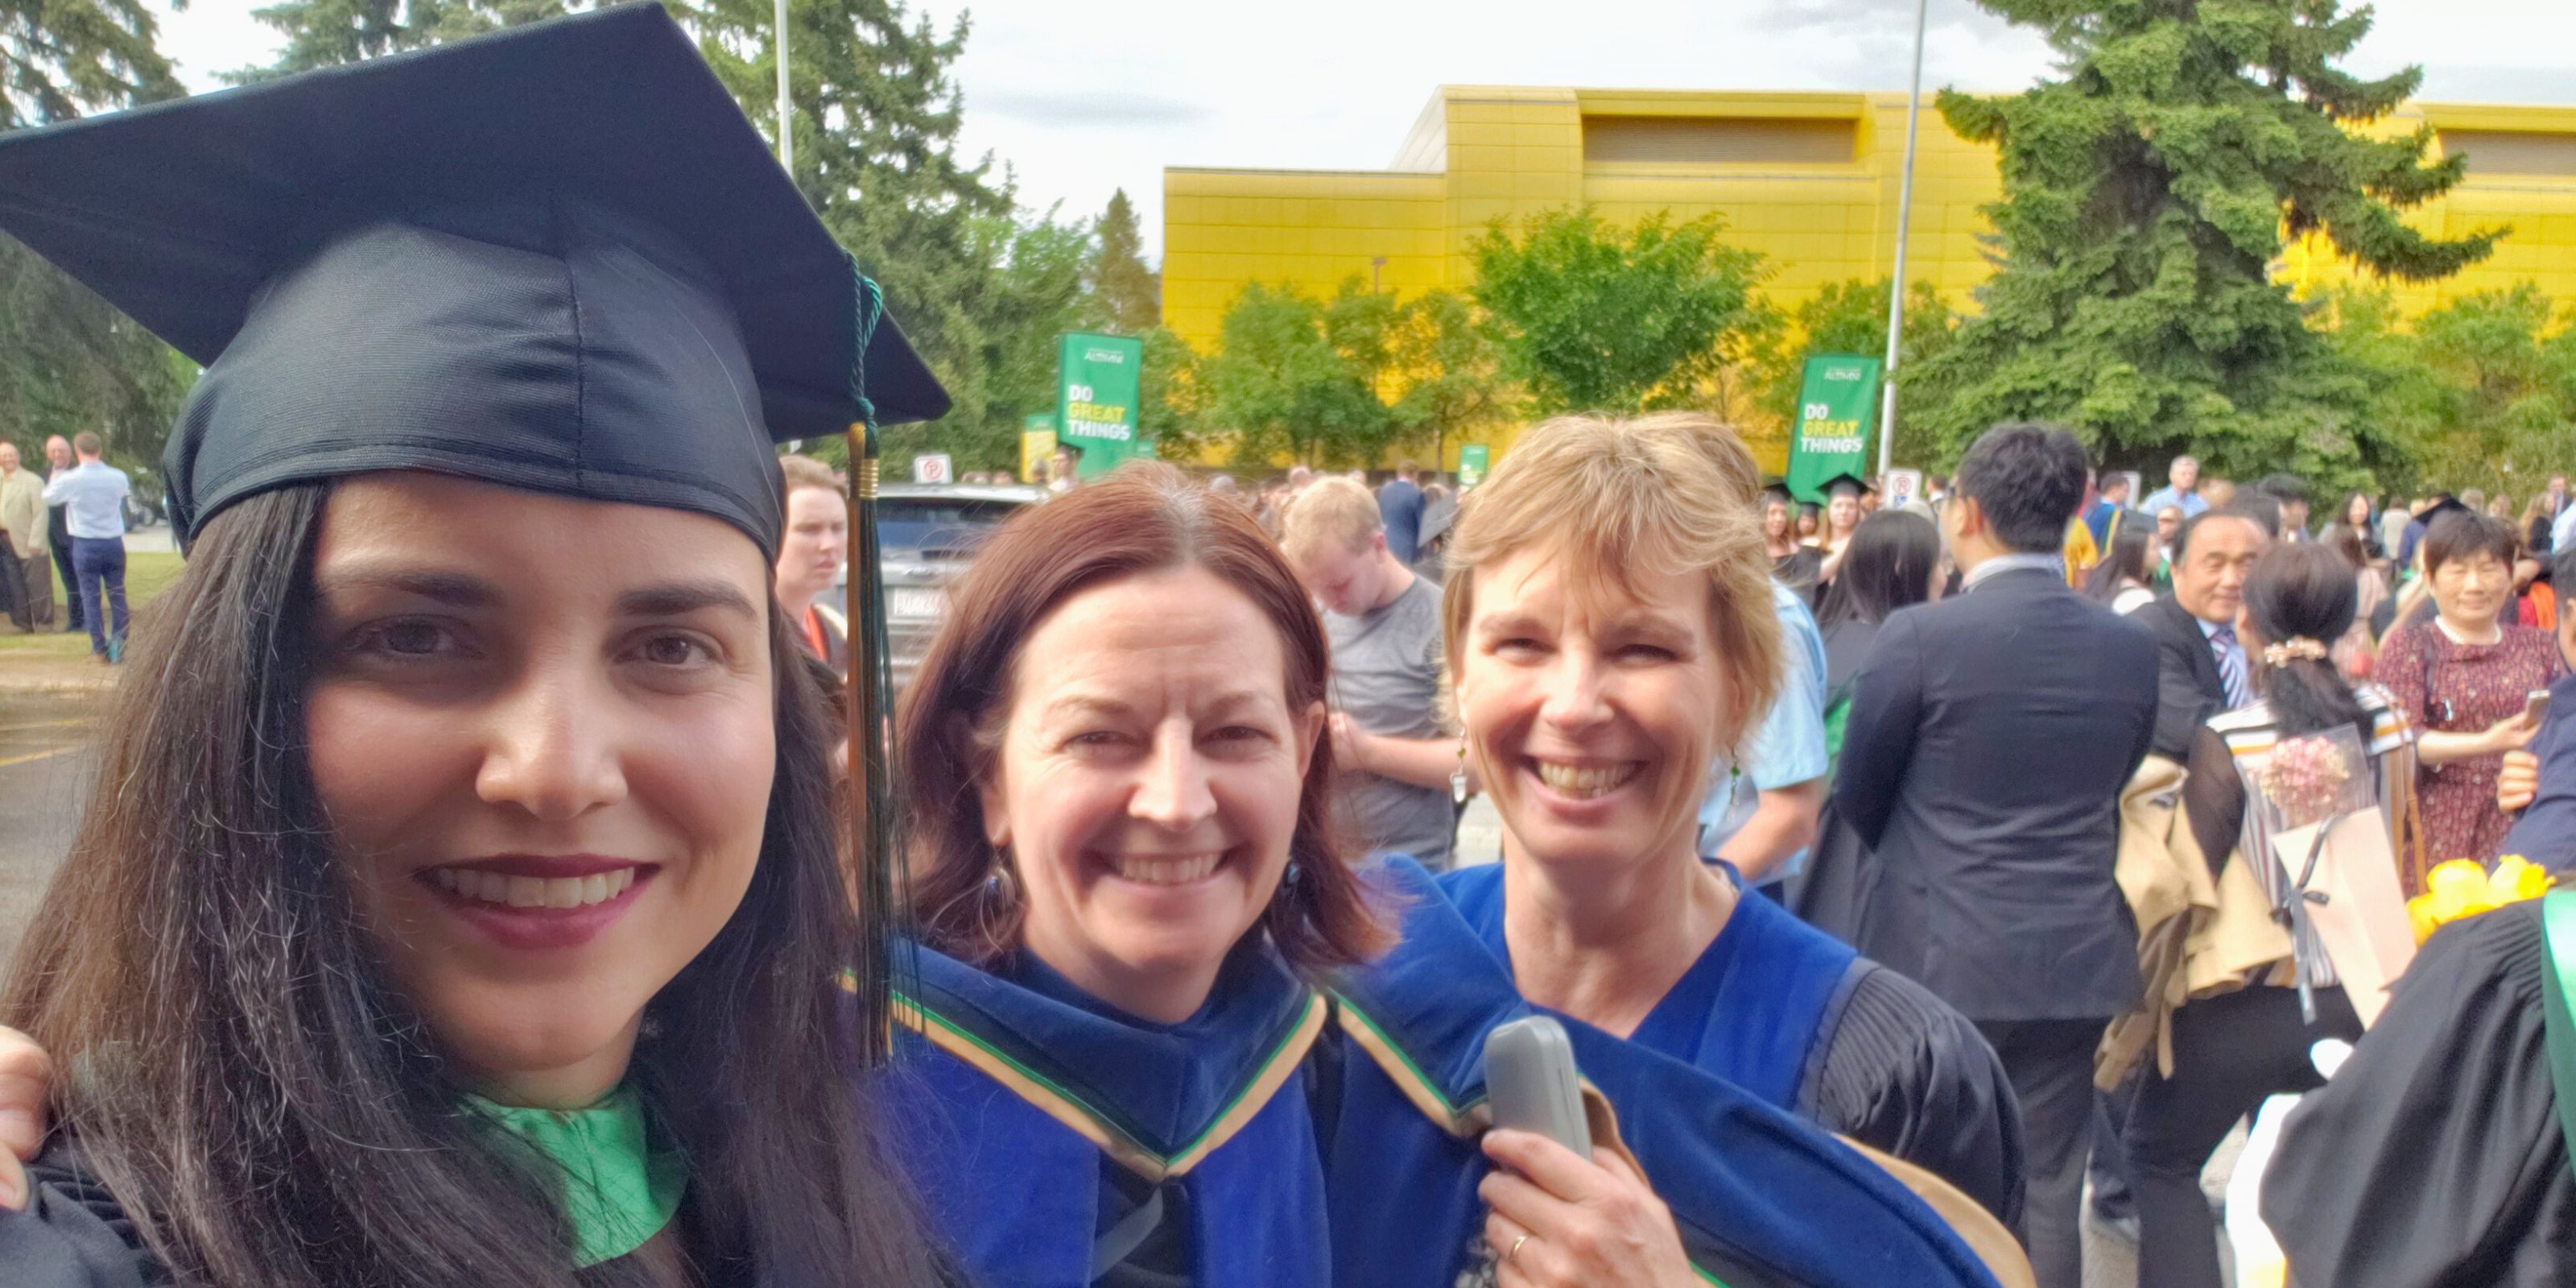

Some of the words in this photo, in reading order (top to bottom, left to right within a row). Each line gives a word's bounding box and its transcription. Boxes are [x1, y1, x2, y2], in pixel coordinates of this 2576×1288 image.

[1069, 385, 1093, 402] DO
[1068, 402, 1125, 423] GREAT
[1805, 403, 1828, 419] DO
[1067, 419, 1130, 440] THINGS
[1802, 420, 1858, 436] GREAT
[1801, 437, 1863, 453] THINGS
